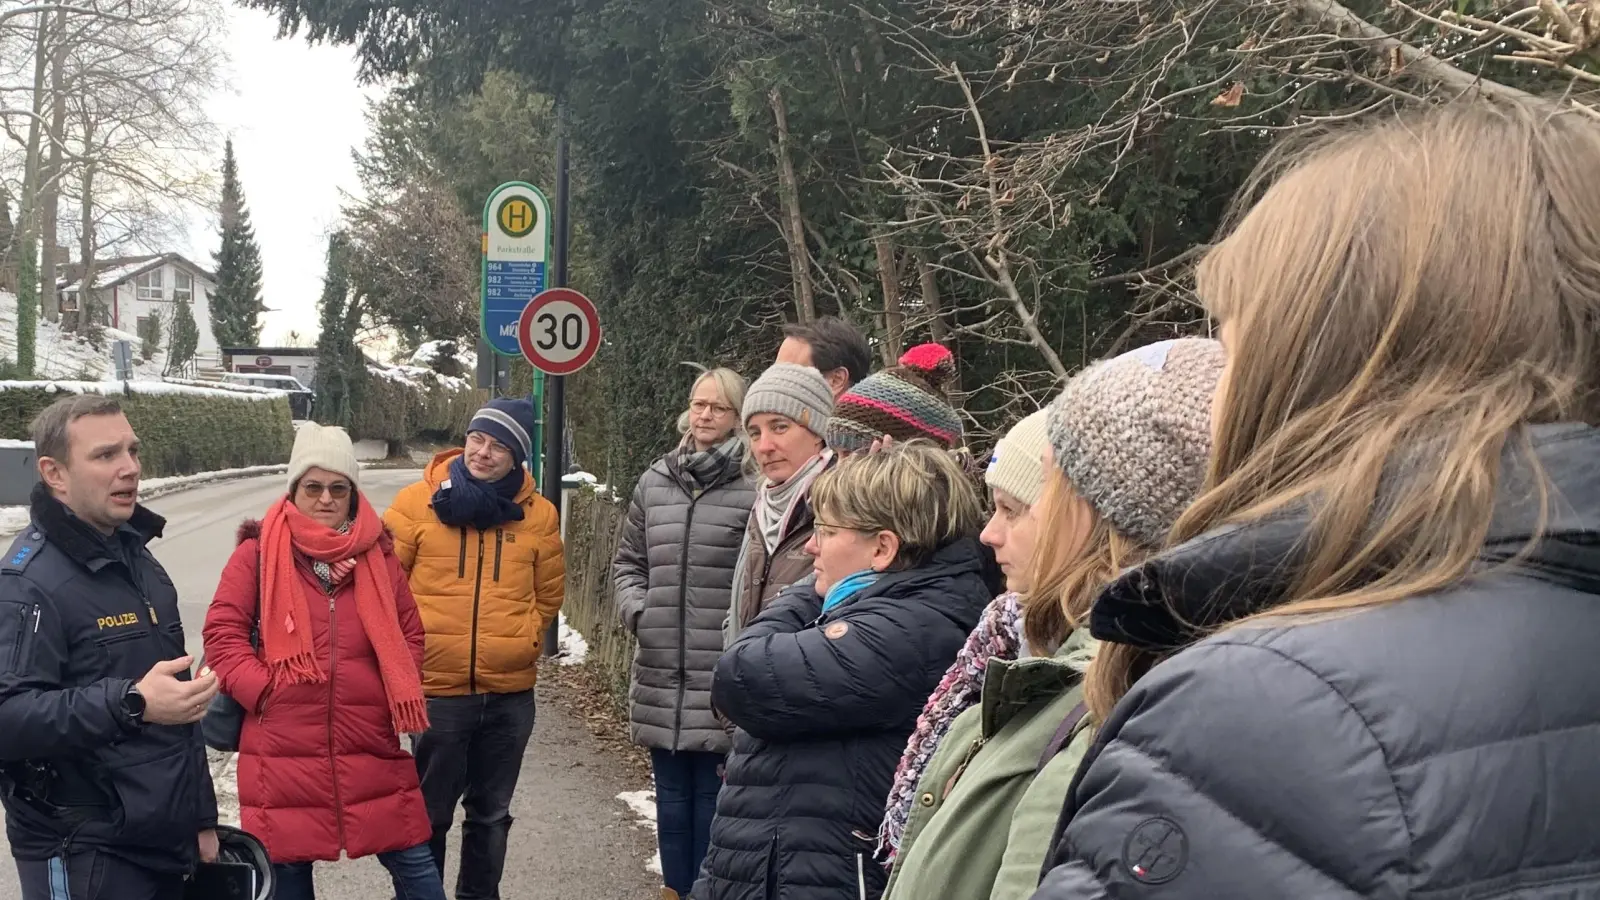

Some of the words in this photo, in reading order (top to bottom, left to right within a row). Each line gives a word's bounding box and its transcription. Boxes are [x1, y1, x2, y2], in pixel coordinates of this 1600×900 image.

[509, 204, 526, 229] H
[497, 244, 536, 254] Parkstraße
[488, 263, 502, 271] 964
[488, 275, 502, 284] 982
[487, 288, 502, 297] 982
[536, 313, 583, 350] 30
[96, 612, 139, 630] POLIZEI
